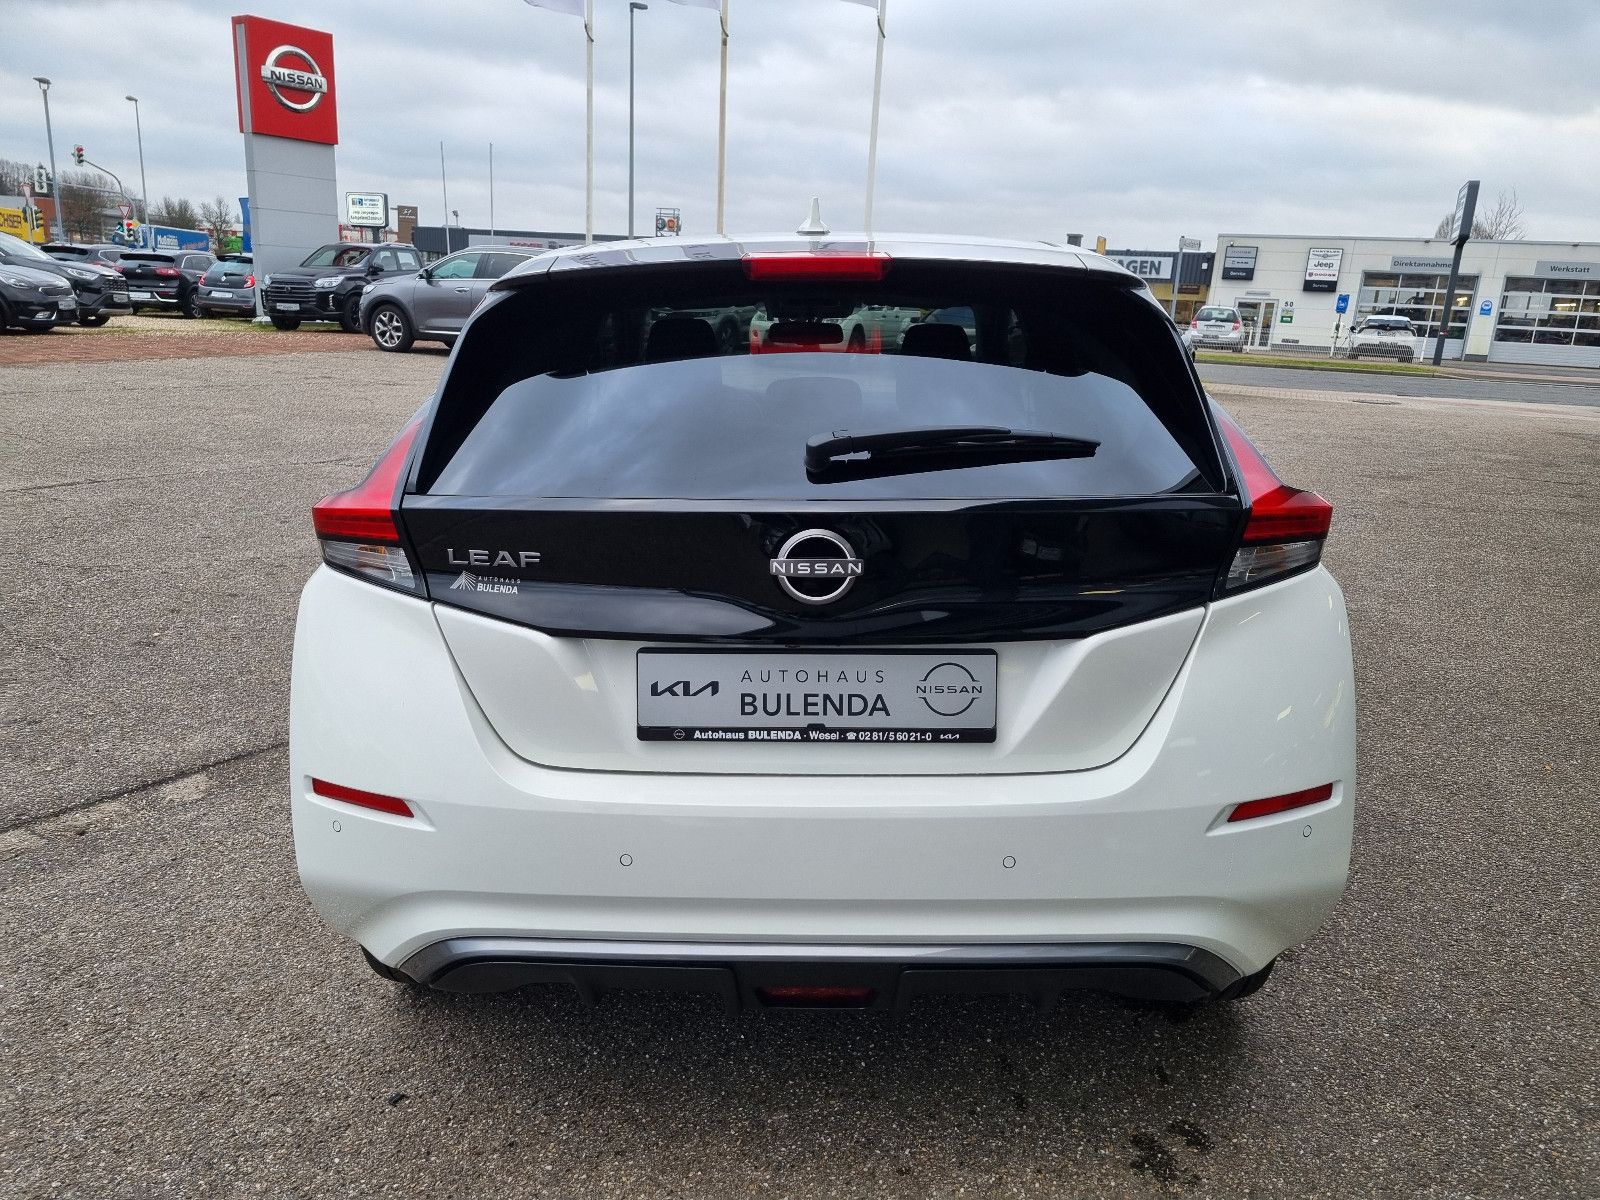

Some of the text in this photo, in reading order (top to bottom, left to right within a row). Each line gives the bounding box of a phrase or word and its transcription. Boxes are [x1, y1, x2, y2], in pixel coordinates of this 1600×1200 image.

[270, 70, 323, 89] NISSAN
[1313, 261, 1334, 269] Jeep
[1393, 260, 1452, 269] Direktannahme
[1549, 265, 1591, 273] Werkstatt
[447, 548, 541, 568] LEAF
[772, 561, 862, 574] NISSAN
[478, 575, 521, 584] AUTOHAUS
[476, 583, 518, 594] BULENDA
[740, 669, 885, 683] AUTOHAUS
[650, 680, 719, 697] KIA
[916, 685, 983, 694] NISSAN
[740, 692, 891, 717] BULENDA
[693, 730, 745, 740] Autohaus
[748, 730, 802, 740] BULENDA
[809, 731, 839, 740] Wesel
